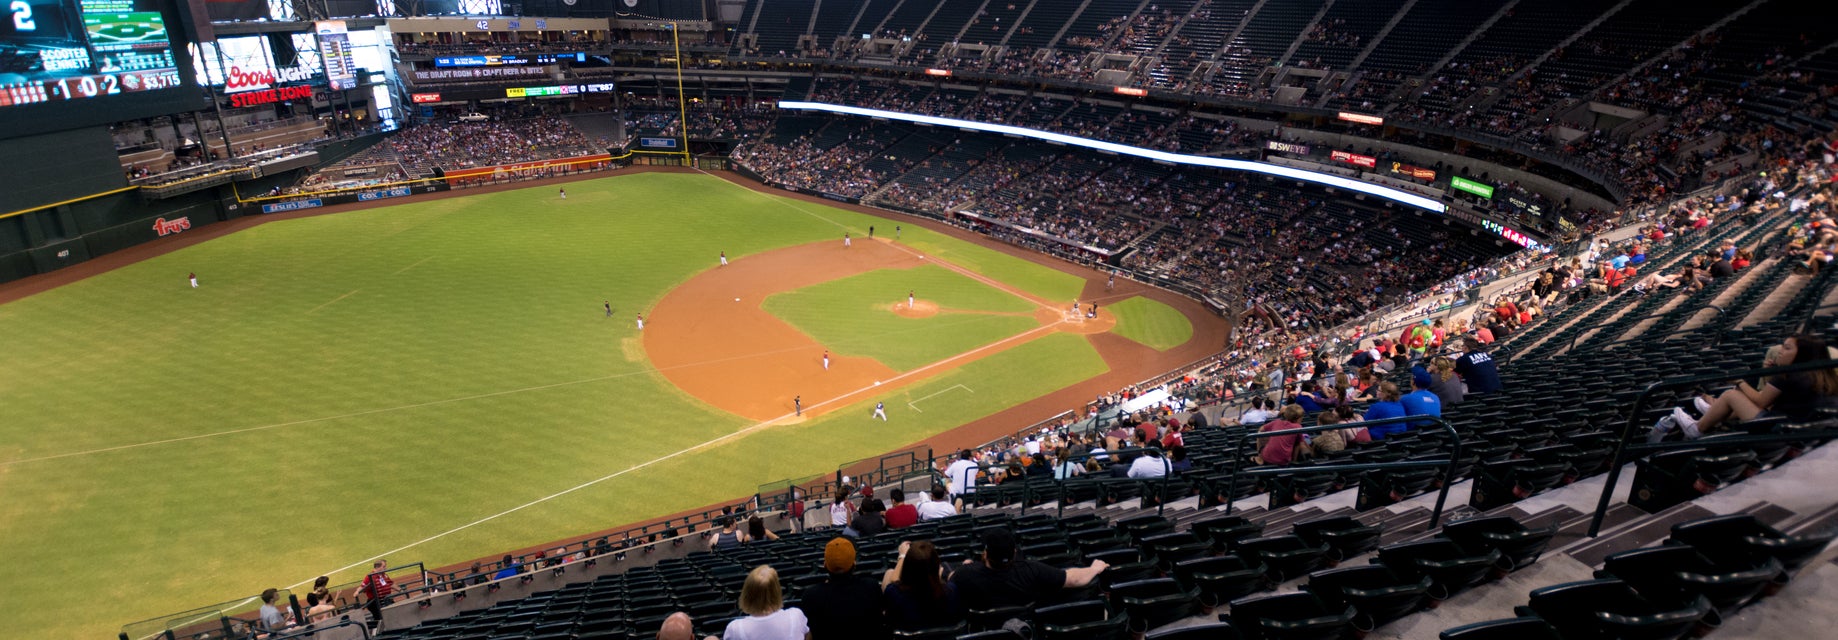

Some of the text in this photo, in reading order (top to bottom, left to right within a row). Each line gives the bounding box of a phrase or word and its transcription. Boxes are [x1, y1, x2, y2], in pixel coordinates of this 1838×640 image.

[10, 1, 36, 30] 2
[476, 20, 489, 30] 42
[40, 48, 89, 60] SCOOTER
[43, 58, 90, 70] GENNETT
[226, 66, 313, 88] Coors LIGHT
[430, 70, 451, 79] DRAFT
[453, 69, 472, 77] ROOM
[482, 68, 502, 76] CRAFT
[503, 67, 519, 75] BEER
[527, 66, 544, 74] BITES
[58, 79, 71, 100] 1
[81, 76, 98, 97] 0
[104, 74, 121, 95] 2
[143, 75, 181, 89] $3,715
[600, 83, 614, 91] 687
[231, 88, 278, 107] STRIKE
[279, 84, 312, 101] ZONE
[543, 162, 572, 173] Farm
[152, 216, 191, 236] fry's
